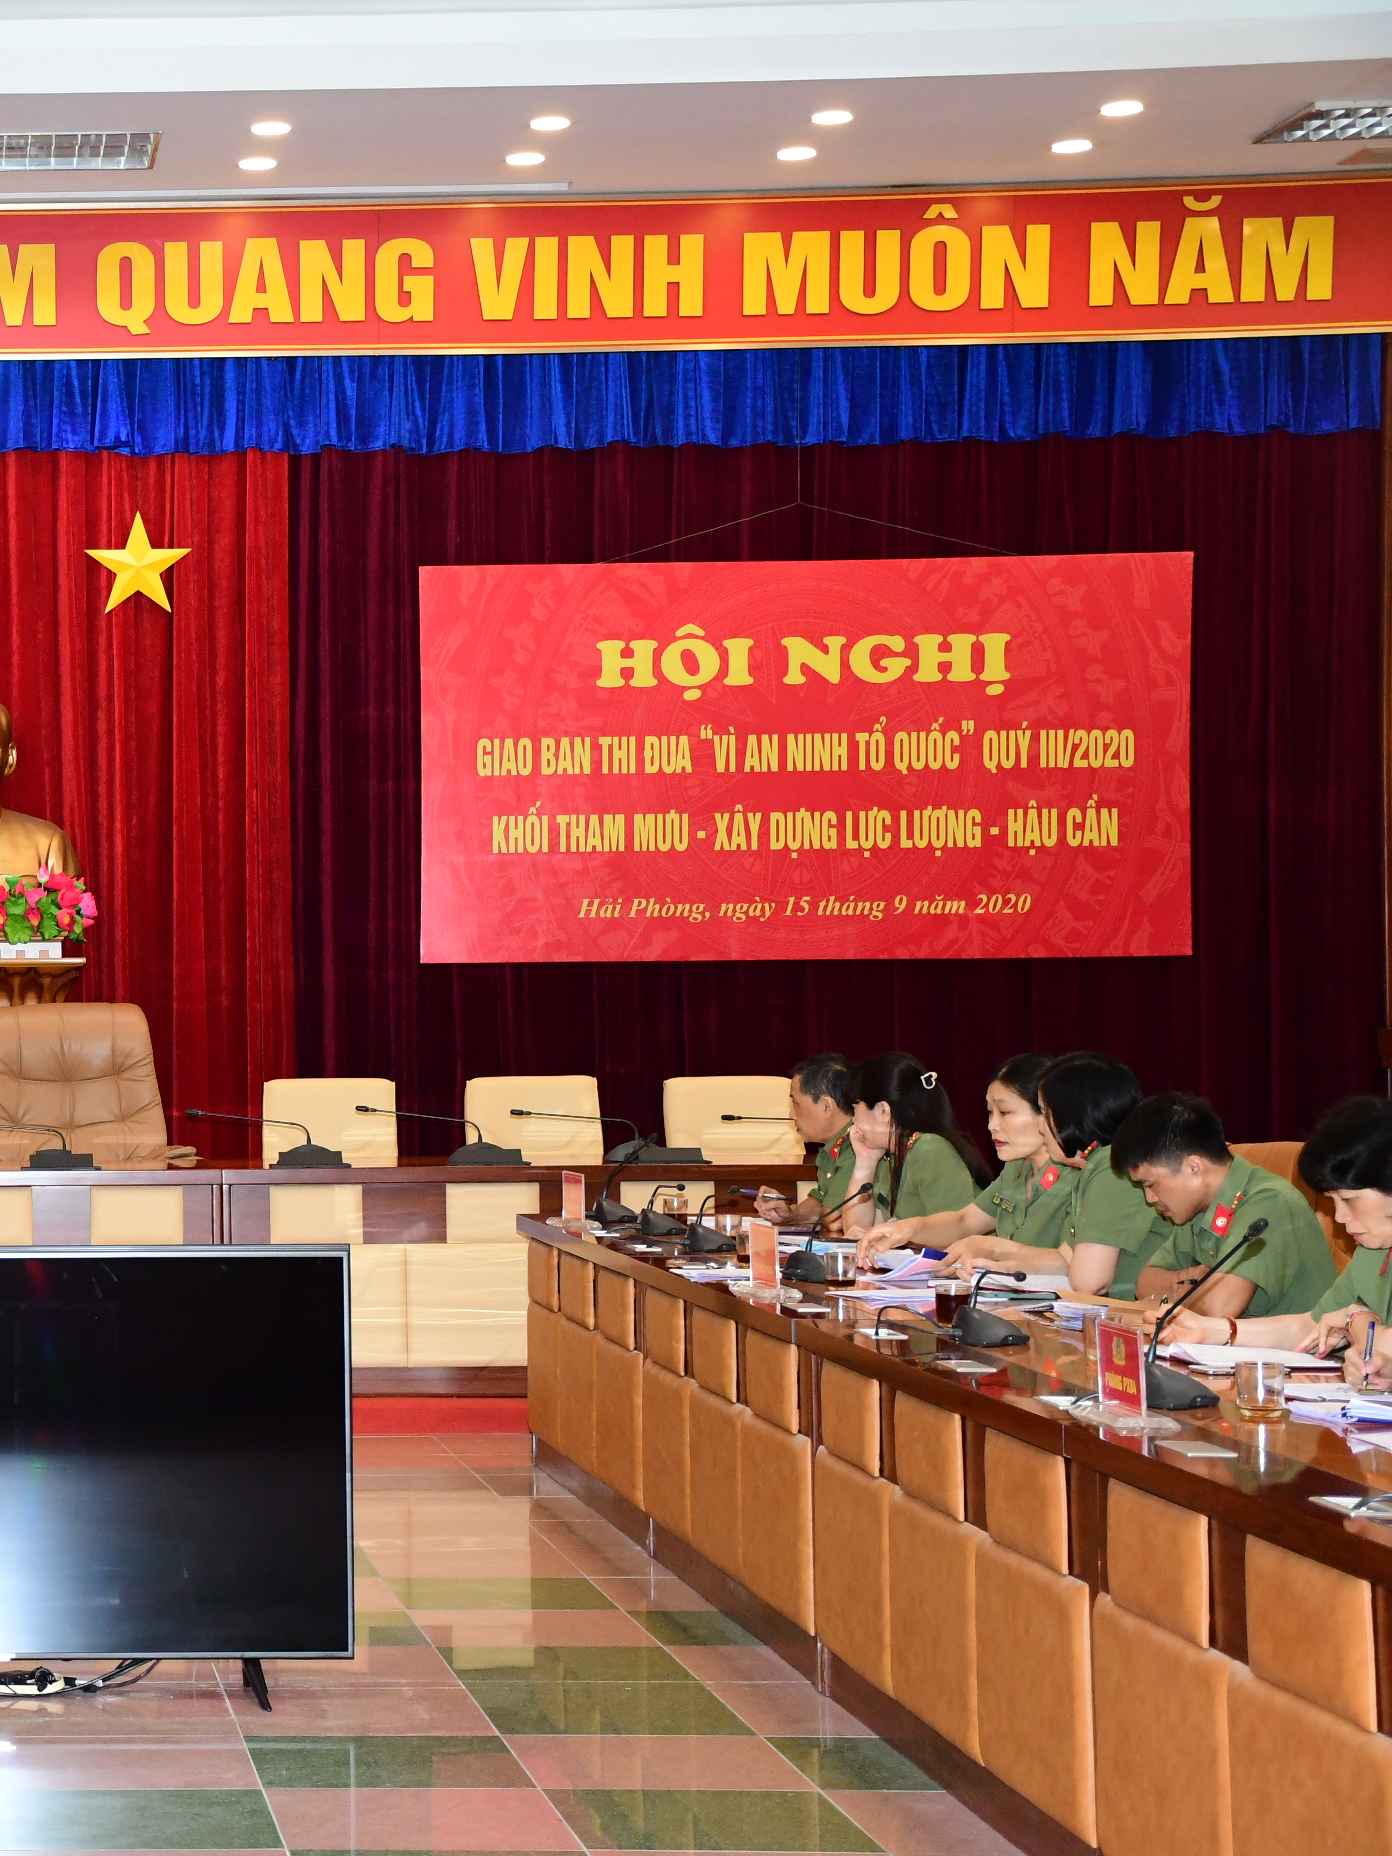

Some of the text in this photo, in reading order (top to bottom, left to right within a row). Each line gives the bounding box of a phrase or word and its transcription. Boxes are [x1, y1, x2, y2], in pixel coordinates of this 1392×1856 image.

[95, 237, 435, 336] QUANG
[470, 233, 704, 321] VINH
[741, 208, 1051, 315] MUÔN
[1089, 194, 1335, 307] NĂM
[597, 623, 1011, 700] HỘI NGHỊ
[477, 737, 533, 776] GIAO
[541, 737, 591, 775] BAN
[599, 736, 636, 774] THI
[644, 735, 692, 773] ĐUA
[745, 734, 778, 772] AN
[787, 733, 847, 771] NINH
[856, 716, 887, 770] TỔ
[983, 722, 1032, 773] QUÝ
[1040, 729, 1135, 768] III/2020
[492, 802, 548, 853] KHỐI
[556, 814, 625, 852] THAM
[634, 810, 689, 851] MƯU
[714, 805, 762, 850] XÂY
[770, 808, 837, 858] DỰNG
[846, 807, 892, 857] LỰC
[900, 806, 982, 856] LƯỢNG
[1008, 800, 1058, 855] HẬU
[1066, 794, 1118, 846] CẦN
[578, 894, 1032, 921] Hải Phòng, ngày 15 tháng 9 năm 2020
